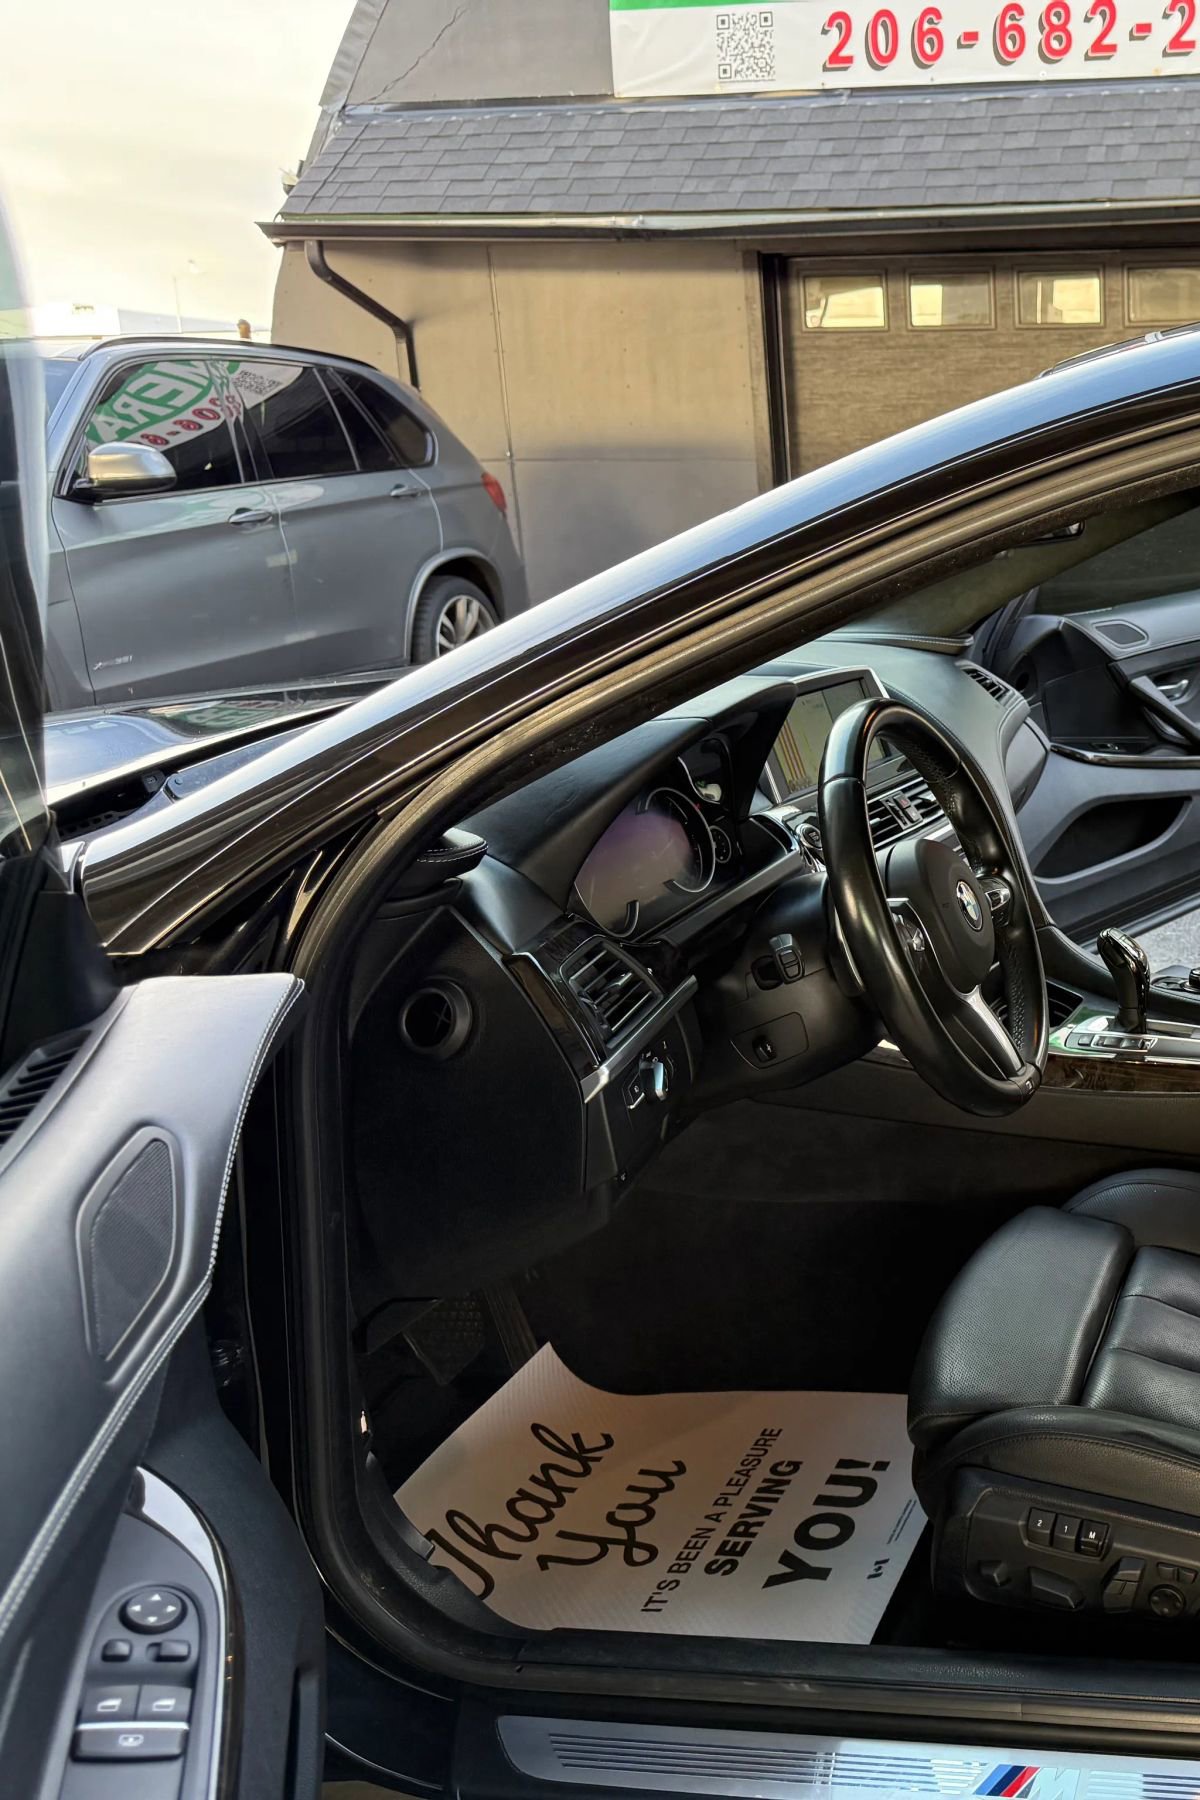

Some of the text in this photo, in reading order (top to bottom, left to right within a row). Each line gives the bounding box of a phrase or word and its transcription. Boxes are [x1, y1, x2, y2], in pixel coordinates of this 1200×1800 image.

[640, 1427, 783, 1613] IT'S BEEN A PLEASURE
[703, 1460, 803, 1576] SERVING
[761, 1457, 892, 1589] YOU!
